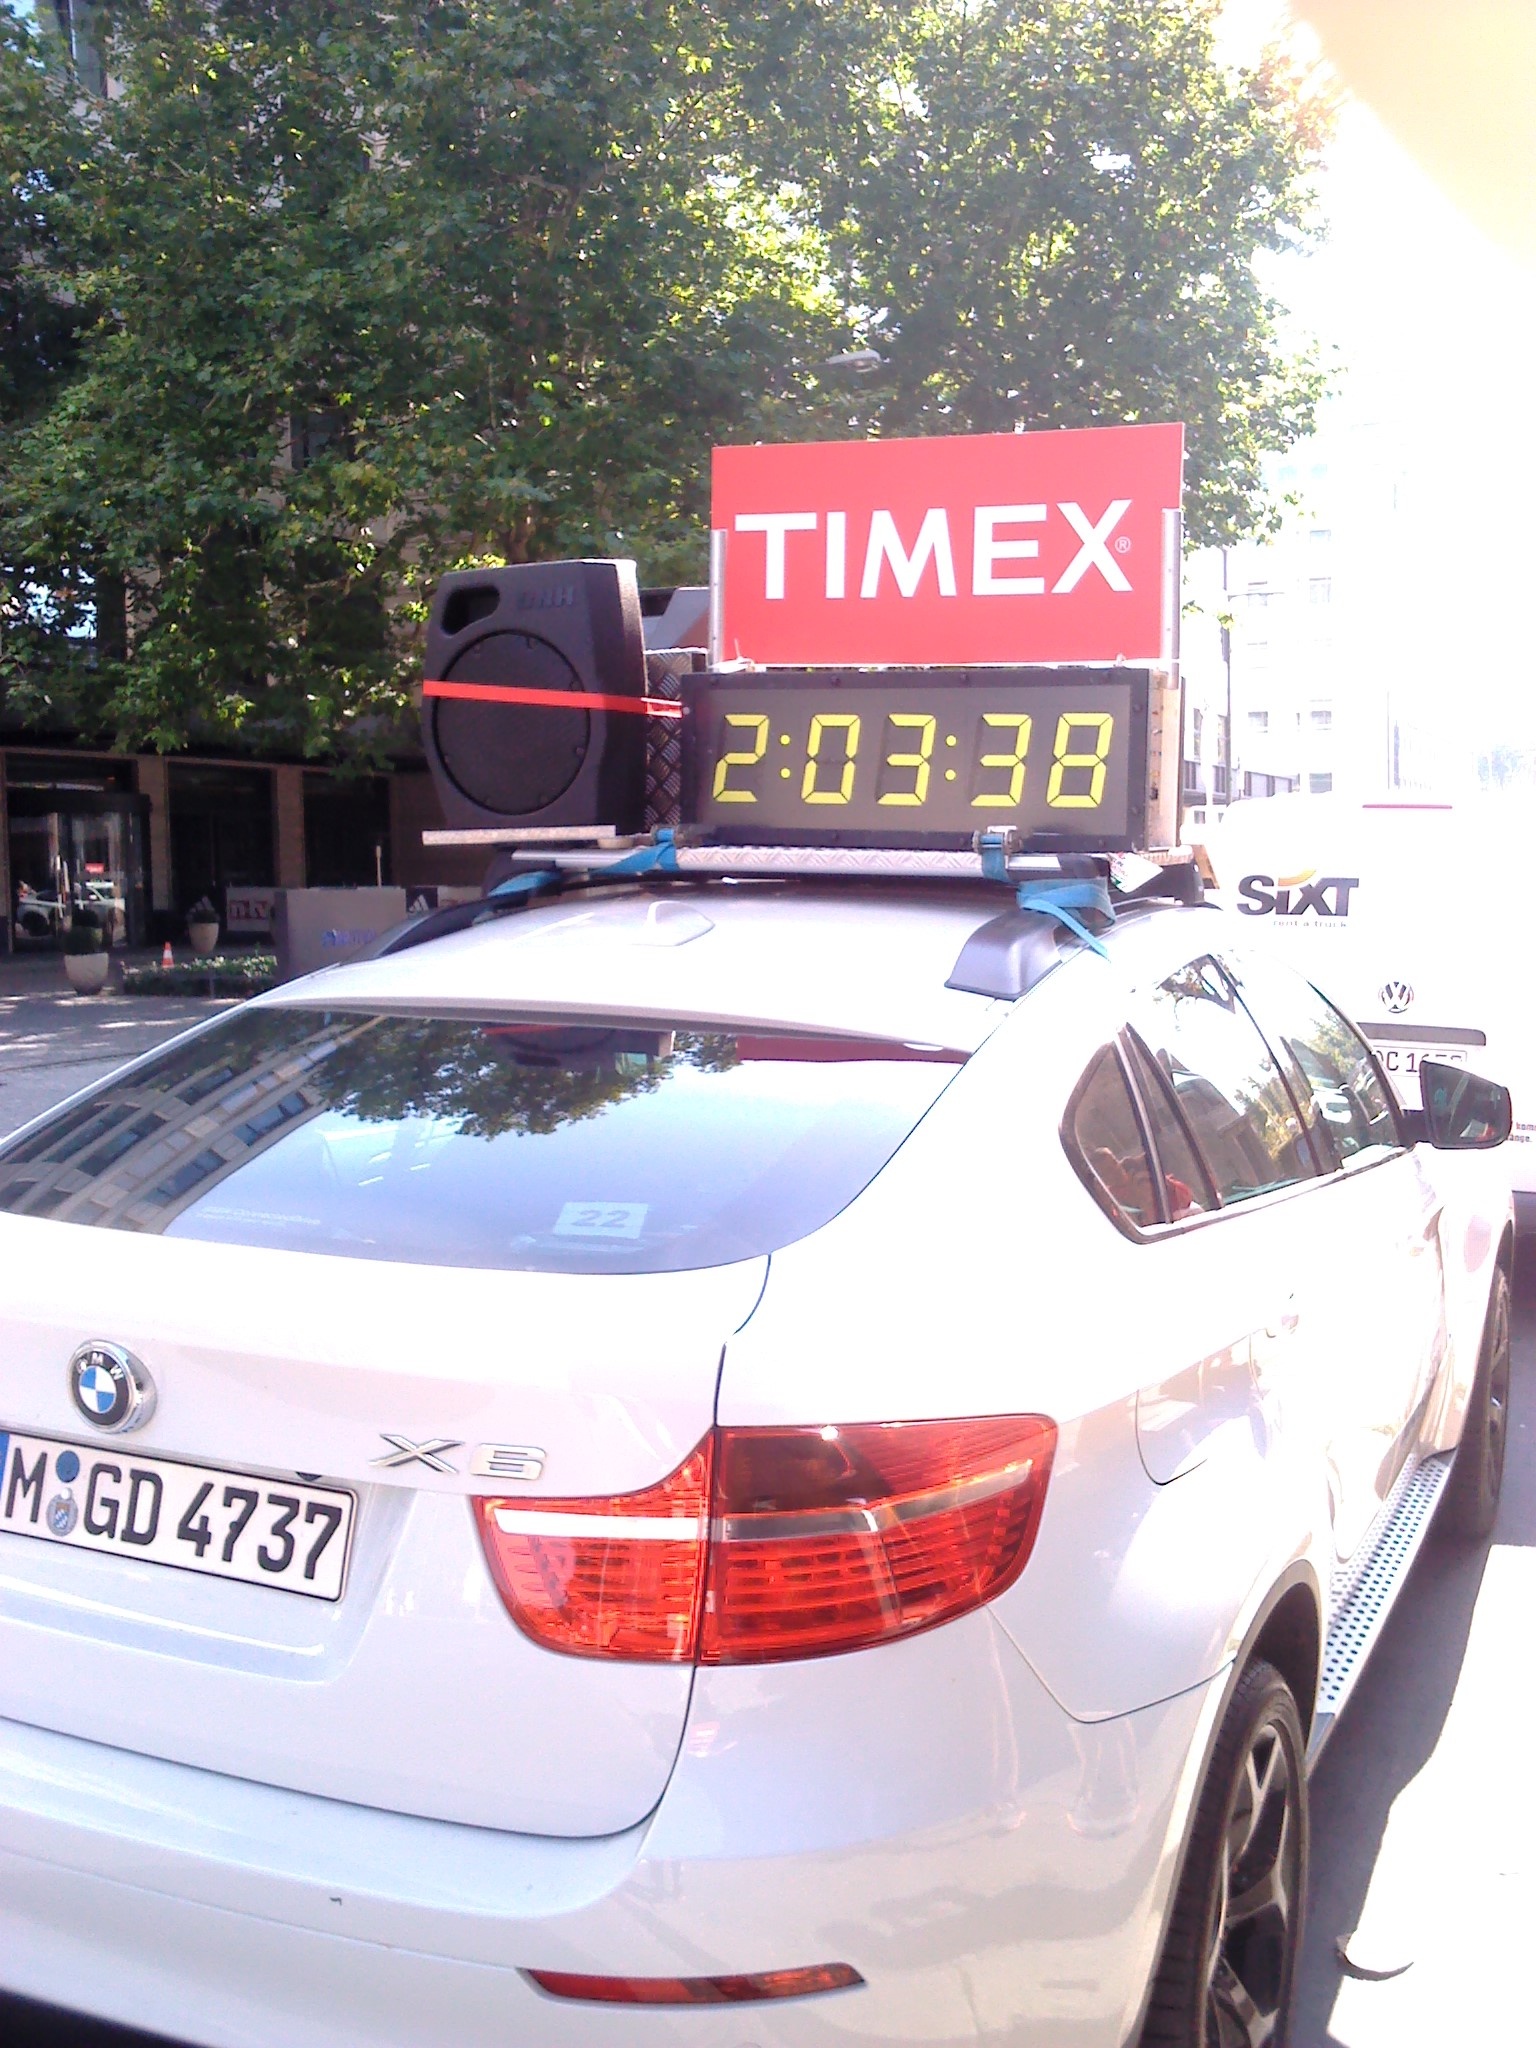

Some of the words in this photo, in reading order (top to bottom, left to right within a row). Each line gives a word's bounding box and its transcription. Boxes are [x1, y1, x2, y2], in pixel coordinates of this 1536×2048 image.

[734, 499, 1133, 600] TIMEX
[712, 713, 1114, 808] 2:03:38
[571, 1209, 632, 1228] 22
[76, 1352, 124, 1381] BMW
[367, 1433, 548, 1481] X6
[5, 1447, 48, 1523] M
[83, 1462, 164, 1546] GD
[176, 1481, 342, 1580] 4737
